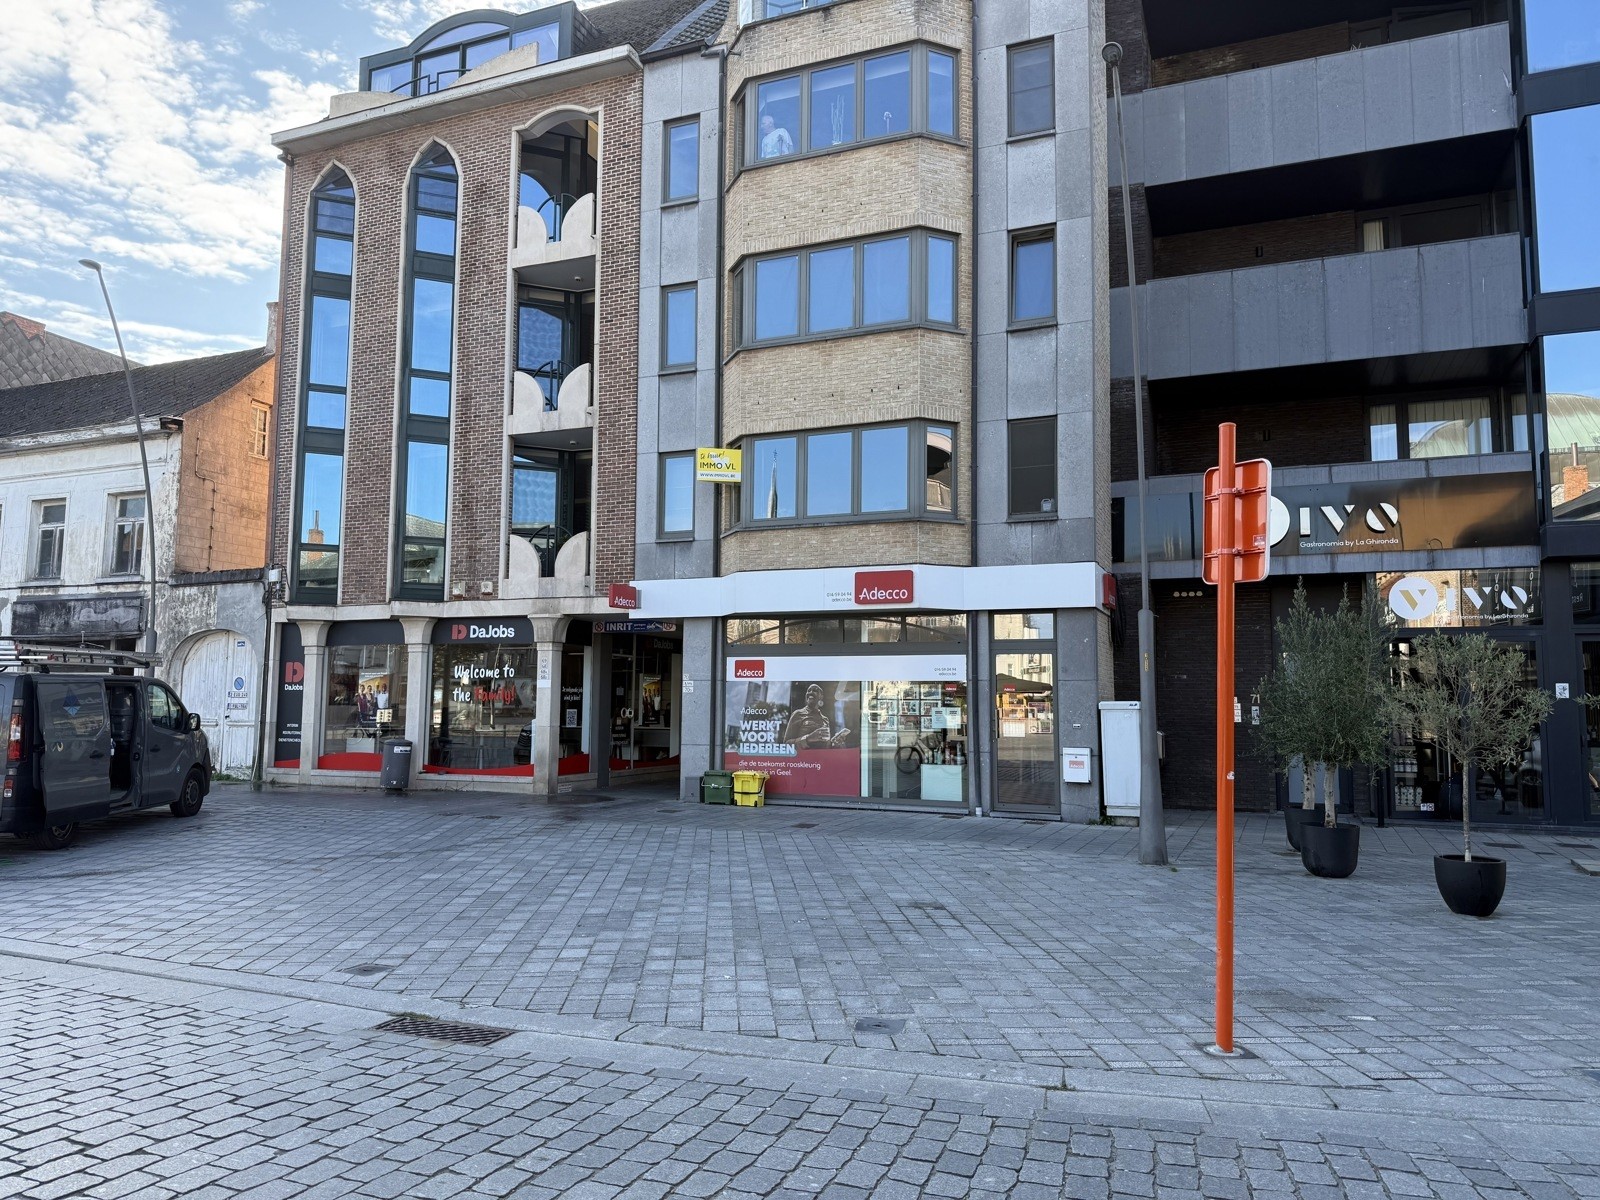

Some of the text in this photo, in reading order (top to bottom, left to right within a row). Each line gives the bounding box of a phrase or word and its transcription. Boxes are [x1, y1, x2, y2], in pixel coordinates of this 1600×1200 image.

[699, 461, 723, 469] IMMO
[1299, 540, 1344, 548] Gastronomia
[1345, 539, 1355, 547] by
[1366, 537, 1399, 545] Ghironda
[859, 586, 908, 600] Adecco
[613, 596, 636, 607] Adecco
[469, 624, 515, 639] DaJobs
[606, 622, 632, 631] INRIT
[454, 663, 515, 679] Welcome to
[736, 668, 763, 676] Adecco
[452, 685, 517, 704] the Family!
[1249, 693, 1260, 704] 71
[740, 706, 768, 715] Adecco
[740, 720, 782, 731] WERKT
[740, 731, 775, 742] VOOR
[739, 743, 795, 755] IEDEREEN
[757, 760, 786, 768] toekomst
[786, 761, 821, 770] rooskleurig
